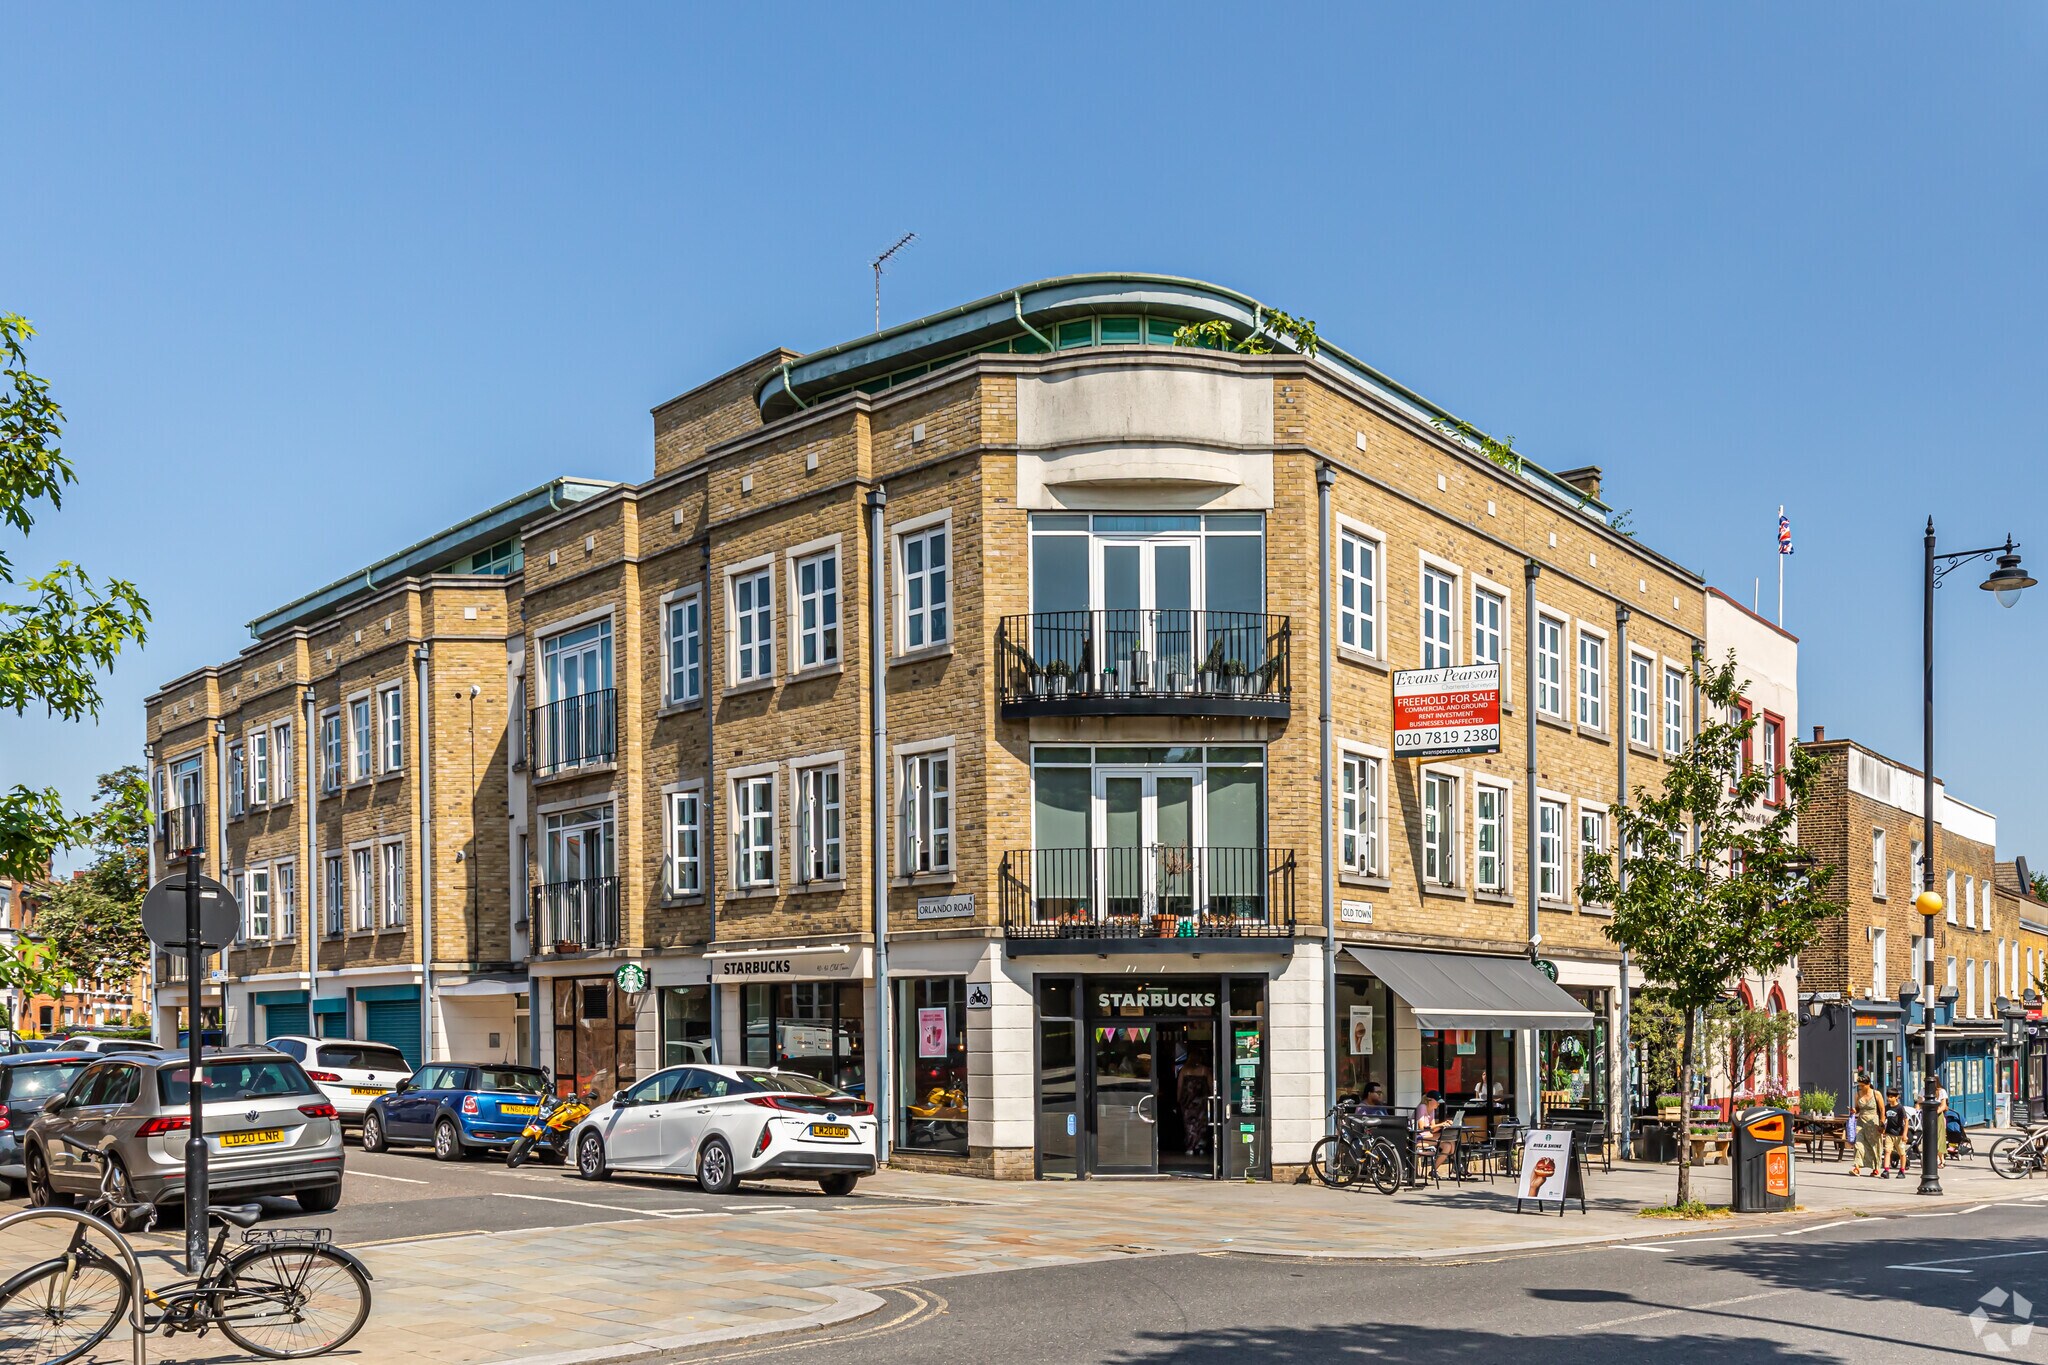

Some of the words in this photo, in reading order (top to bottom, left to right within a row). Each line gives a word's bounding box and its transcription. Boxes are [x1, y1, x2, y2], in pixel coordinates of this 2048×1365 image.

[1396, 672, 1439, 686] Evans
[1443, 668, 1498, 682] Pearson
[1398, 696, 1448, 706] FREEHOLD
[1450, 694, 1470, 703] FOR
[1472, 692, 1496, 702] SALE
[1396, 733, 1420, 746] 020
[1425, 730, 1458, 744] 7819
[1464, 728, 1498, 742] 2380
[919, 904, 952, 914] ORLANDO
[954, 902, 972, 912] ROAD
[1343, 908, 1354, 916] OLD
[1355, 910, 1372, 918] TOWN
[724, 960, 790, 974] STARBUCKS
[1098, 993, 1216, 1007] STARBUCKS
[814, 1126, 833, 1134] LM20
[225, 1133, 255, 1144] LD20
[258, 1131, 280, 1141] LNR
